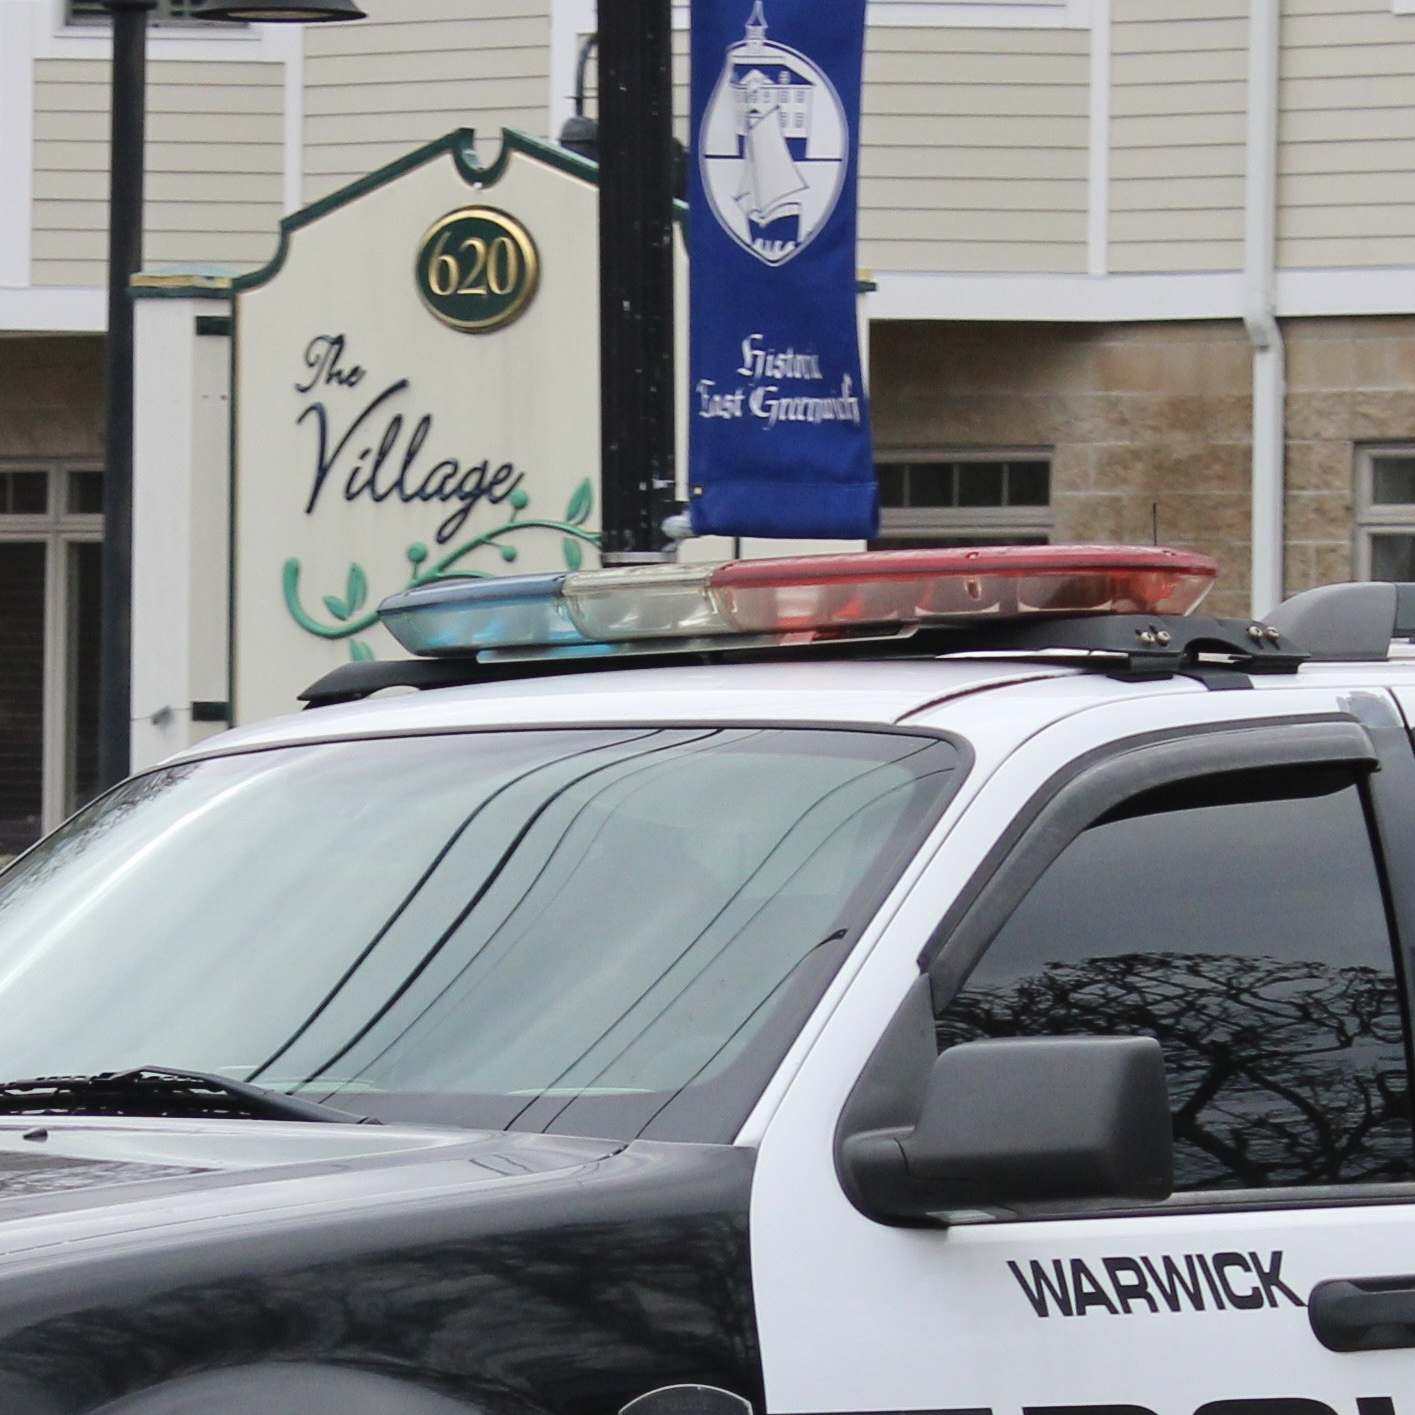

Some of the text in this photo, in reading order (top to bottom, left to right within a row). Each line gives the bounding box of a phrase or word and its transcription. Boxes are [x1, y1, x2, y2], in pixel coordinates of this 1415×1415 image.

[428, 231, 517, 296] 620
[294, 333, 367, 392] The
[296, 378, 525, 543] Village
[1007, 1250, 1307, 1318] WARWICK
